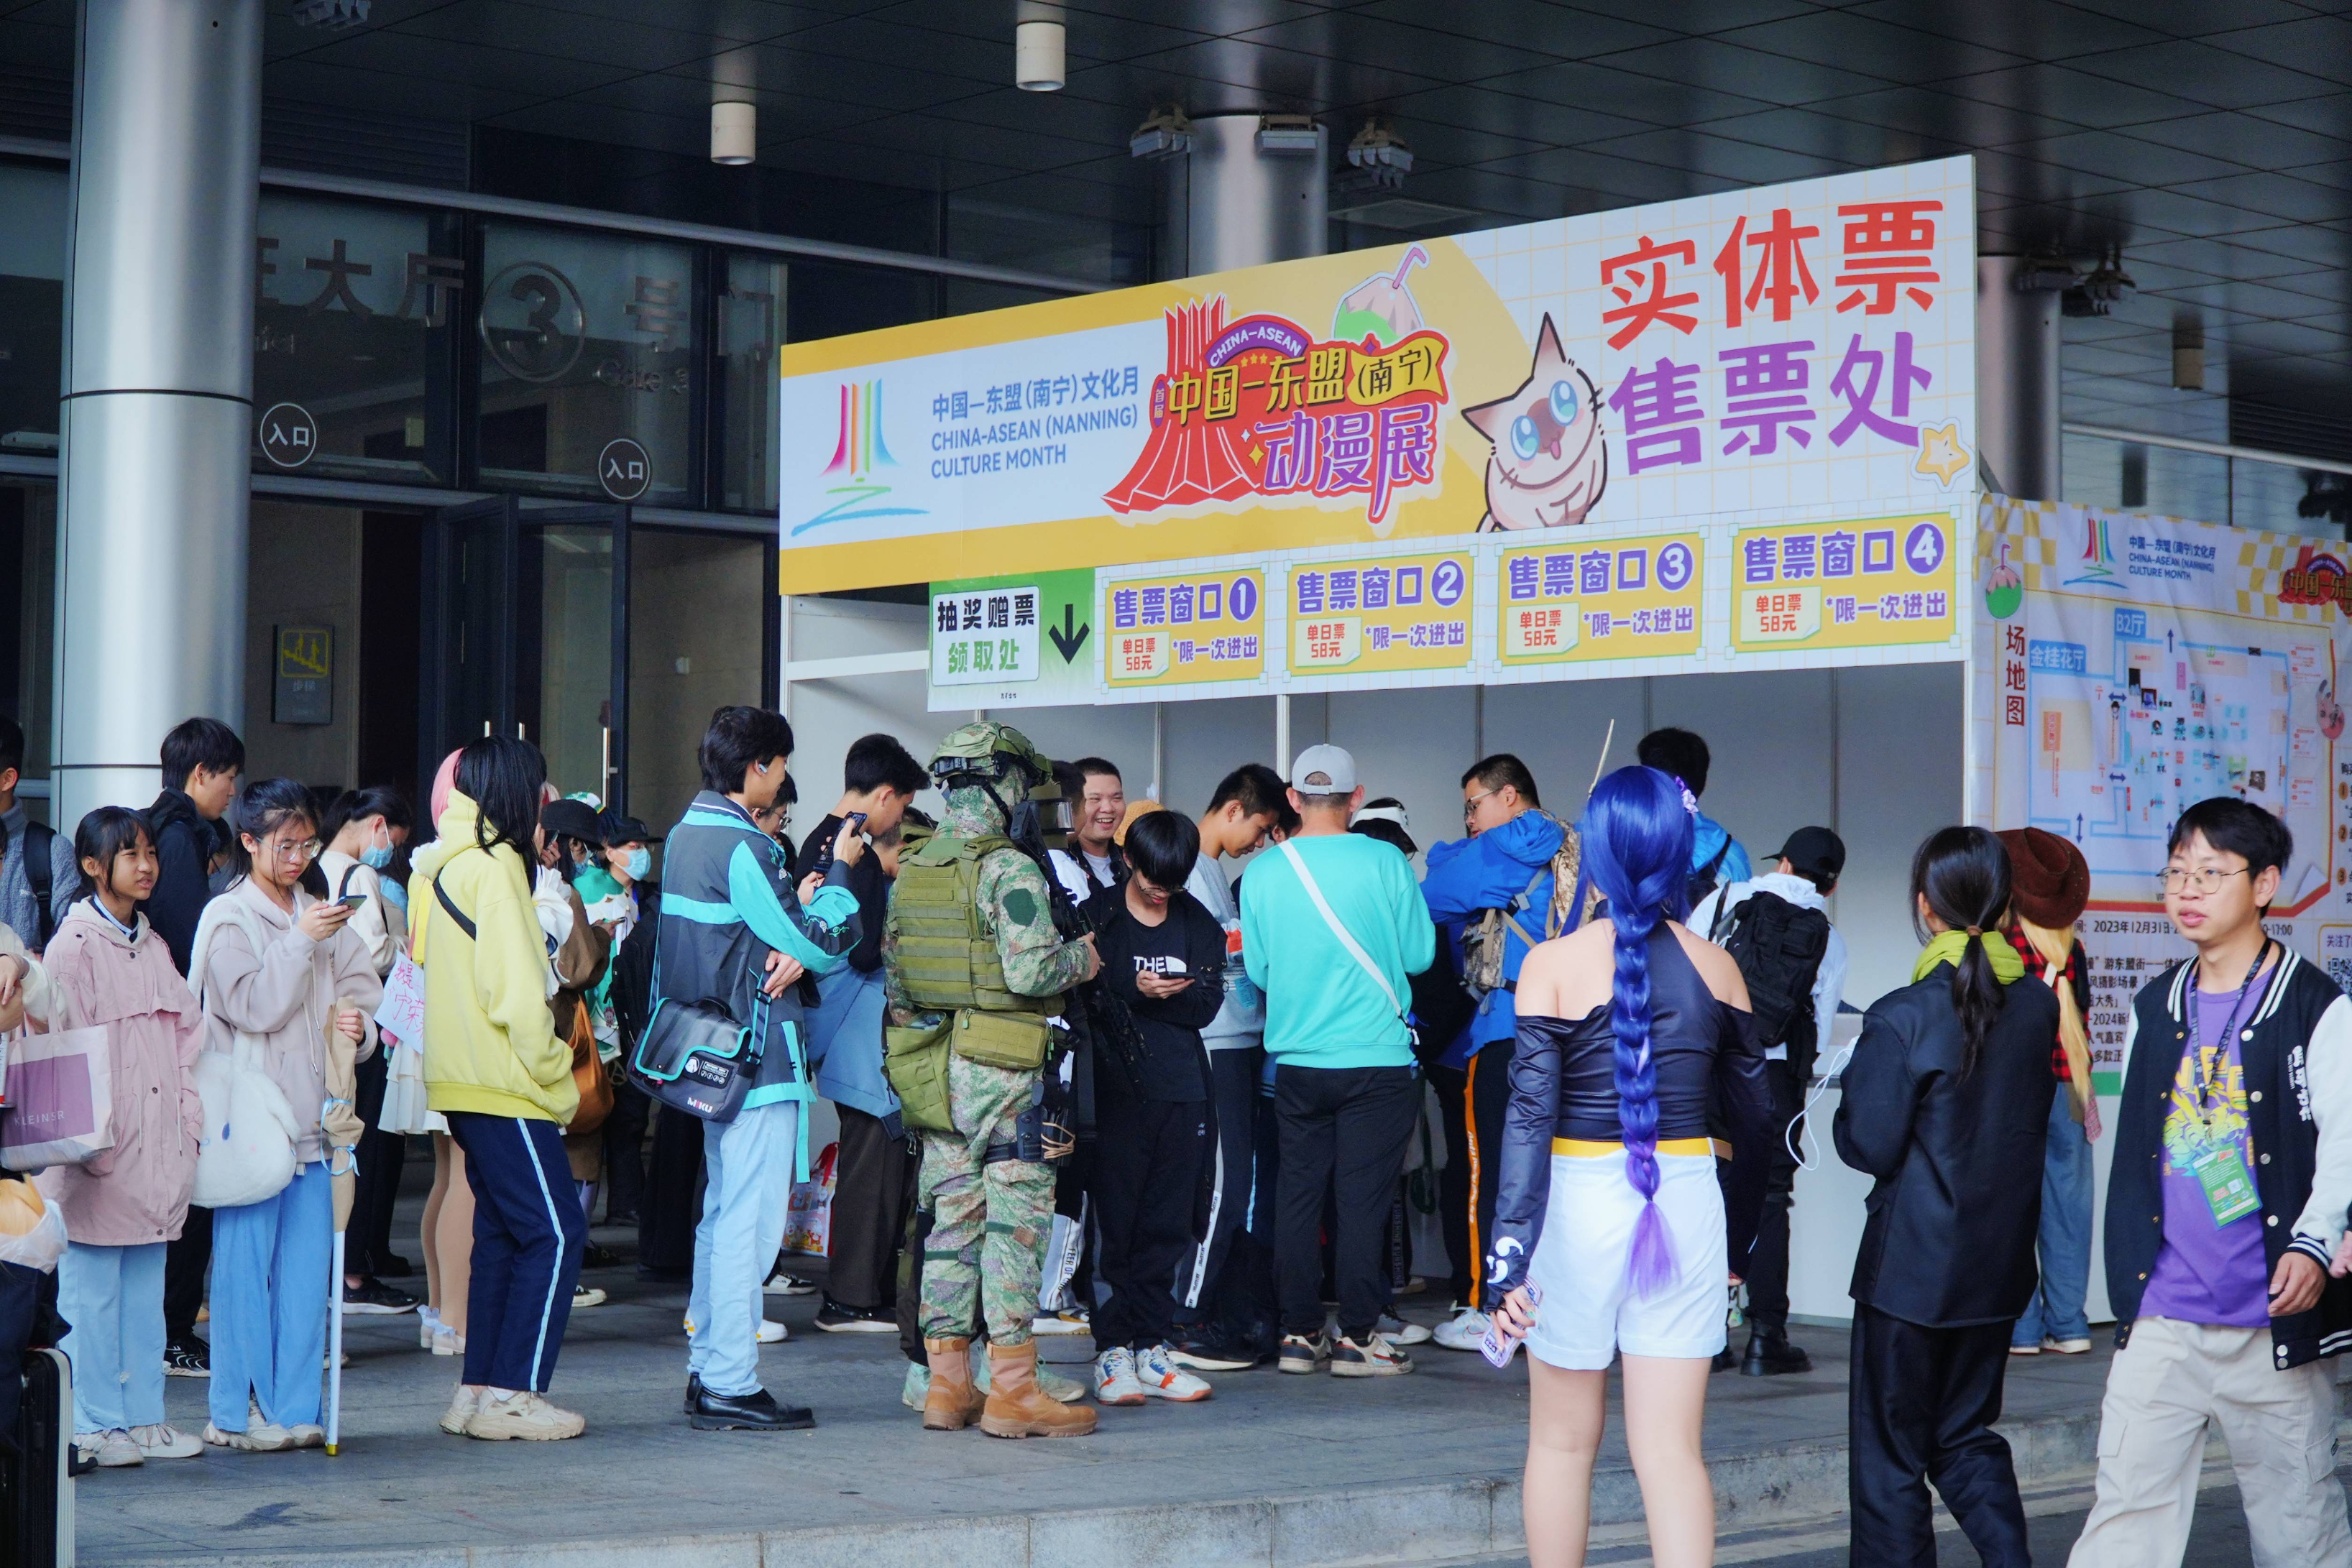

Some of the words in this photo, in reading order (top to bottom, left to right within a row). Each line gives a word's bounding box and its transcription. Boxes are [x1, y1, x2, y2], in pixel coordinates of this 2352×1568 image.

[1600, 200, 1943, 351] 实体票
[1210, 324, 1303, 367] CHINA-ASEAN
[1154, 387, 1164, 420] 首届
[1608, 331, 1932, 475] 售票处
[268, 422, 309, 447] 入口
[932, 419, 1041, 451] CHINA-ASEAN
[1046, 404, 1138, 440] (NANNING)
[607, 459, 643, 480] 入口
[931, 451, 1001, 478] CULTURE
[1006, 444, 1066, 470] MONTH
[1256, 404, 1432, 518] 动漫展
[2129, 565, 2162, 577] CULTURE
[2164, 570, 2191, 580] MONTH
[938, 594, 1034, 632] 抽奖赠票
[1756, 594, 1802, 614] 单日票
[1520, 610, 1561, 628] 单日票
[1760, 614, 1797, 633] 58元
[2116, 614, 2145, 636] B2厅
[1308, 623, 1345, 641] 单日票
[1524, 629, 1557, 647] 58元
[948, 639, 1019, 673] 领取处
[1123, 638, 1155, 654] 单日票
[1311, 642, 1341, 658] 58元
[1126, 656, 1152, 671] 58元
[2030, 646, 2084, 671] 金桂花厅
[2006, 625, 2026, 727] 场地图
[1134, 956, 1165, 972] THE
